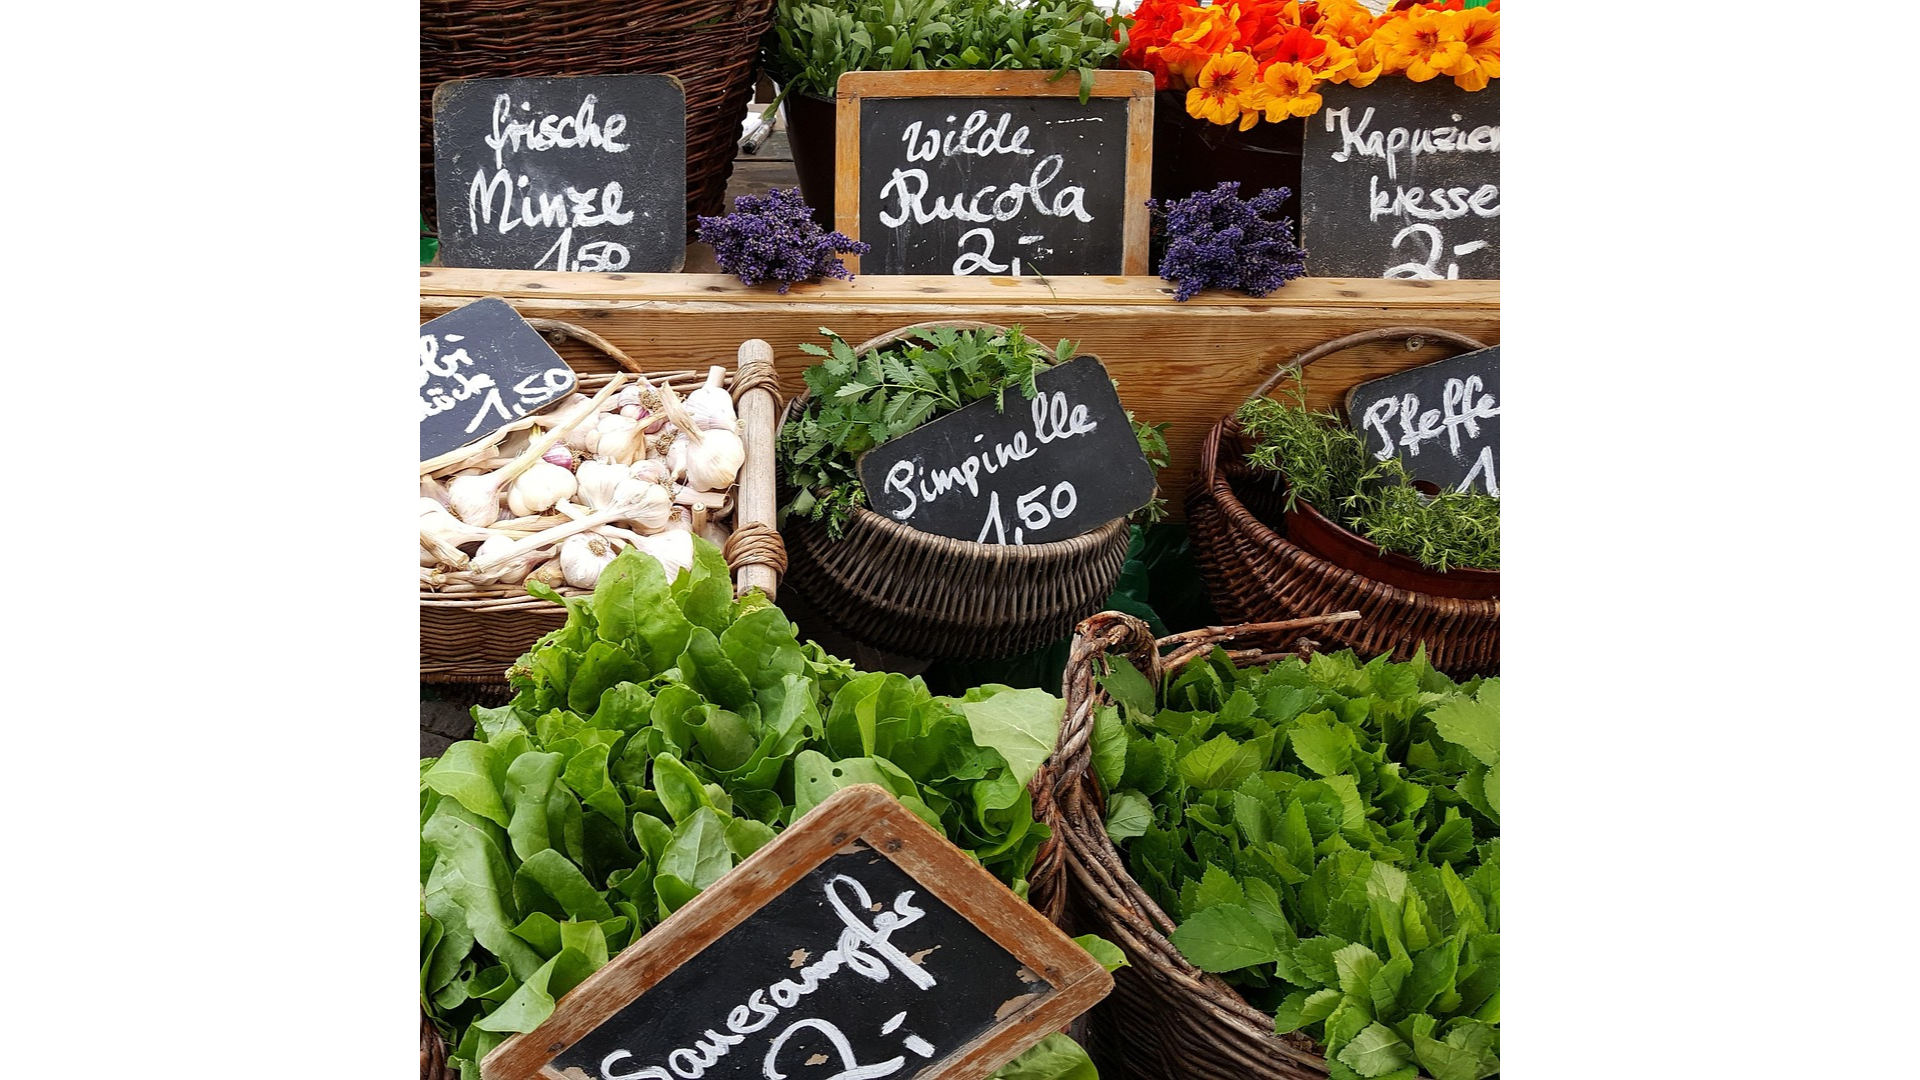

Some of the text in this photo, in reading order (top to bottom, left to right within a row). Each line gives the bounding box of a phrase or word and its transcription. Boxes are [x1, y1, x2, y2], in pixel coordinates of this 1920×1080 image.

[485, 93, 631, 170] frische
[902, 110, 1036, 163] wilde
[469, 168, 635, 234] Minze
[879, 154, 1095, 229] Rucola
[534, 227, 631, 273] 1,50
[465, 368, 575, 433] 1,50
[884, 391, 1098, 520] Pimpinelle
[976, 480, 1078, 546] 1,50
[600, 874, 937, 1080] Sauerampfer
